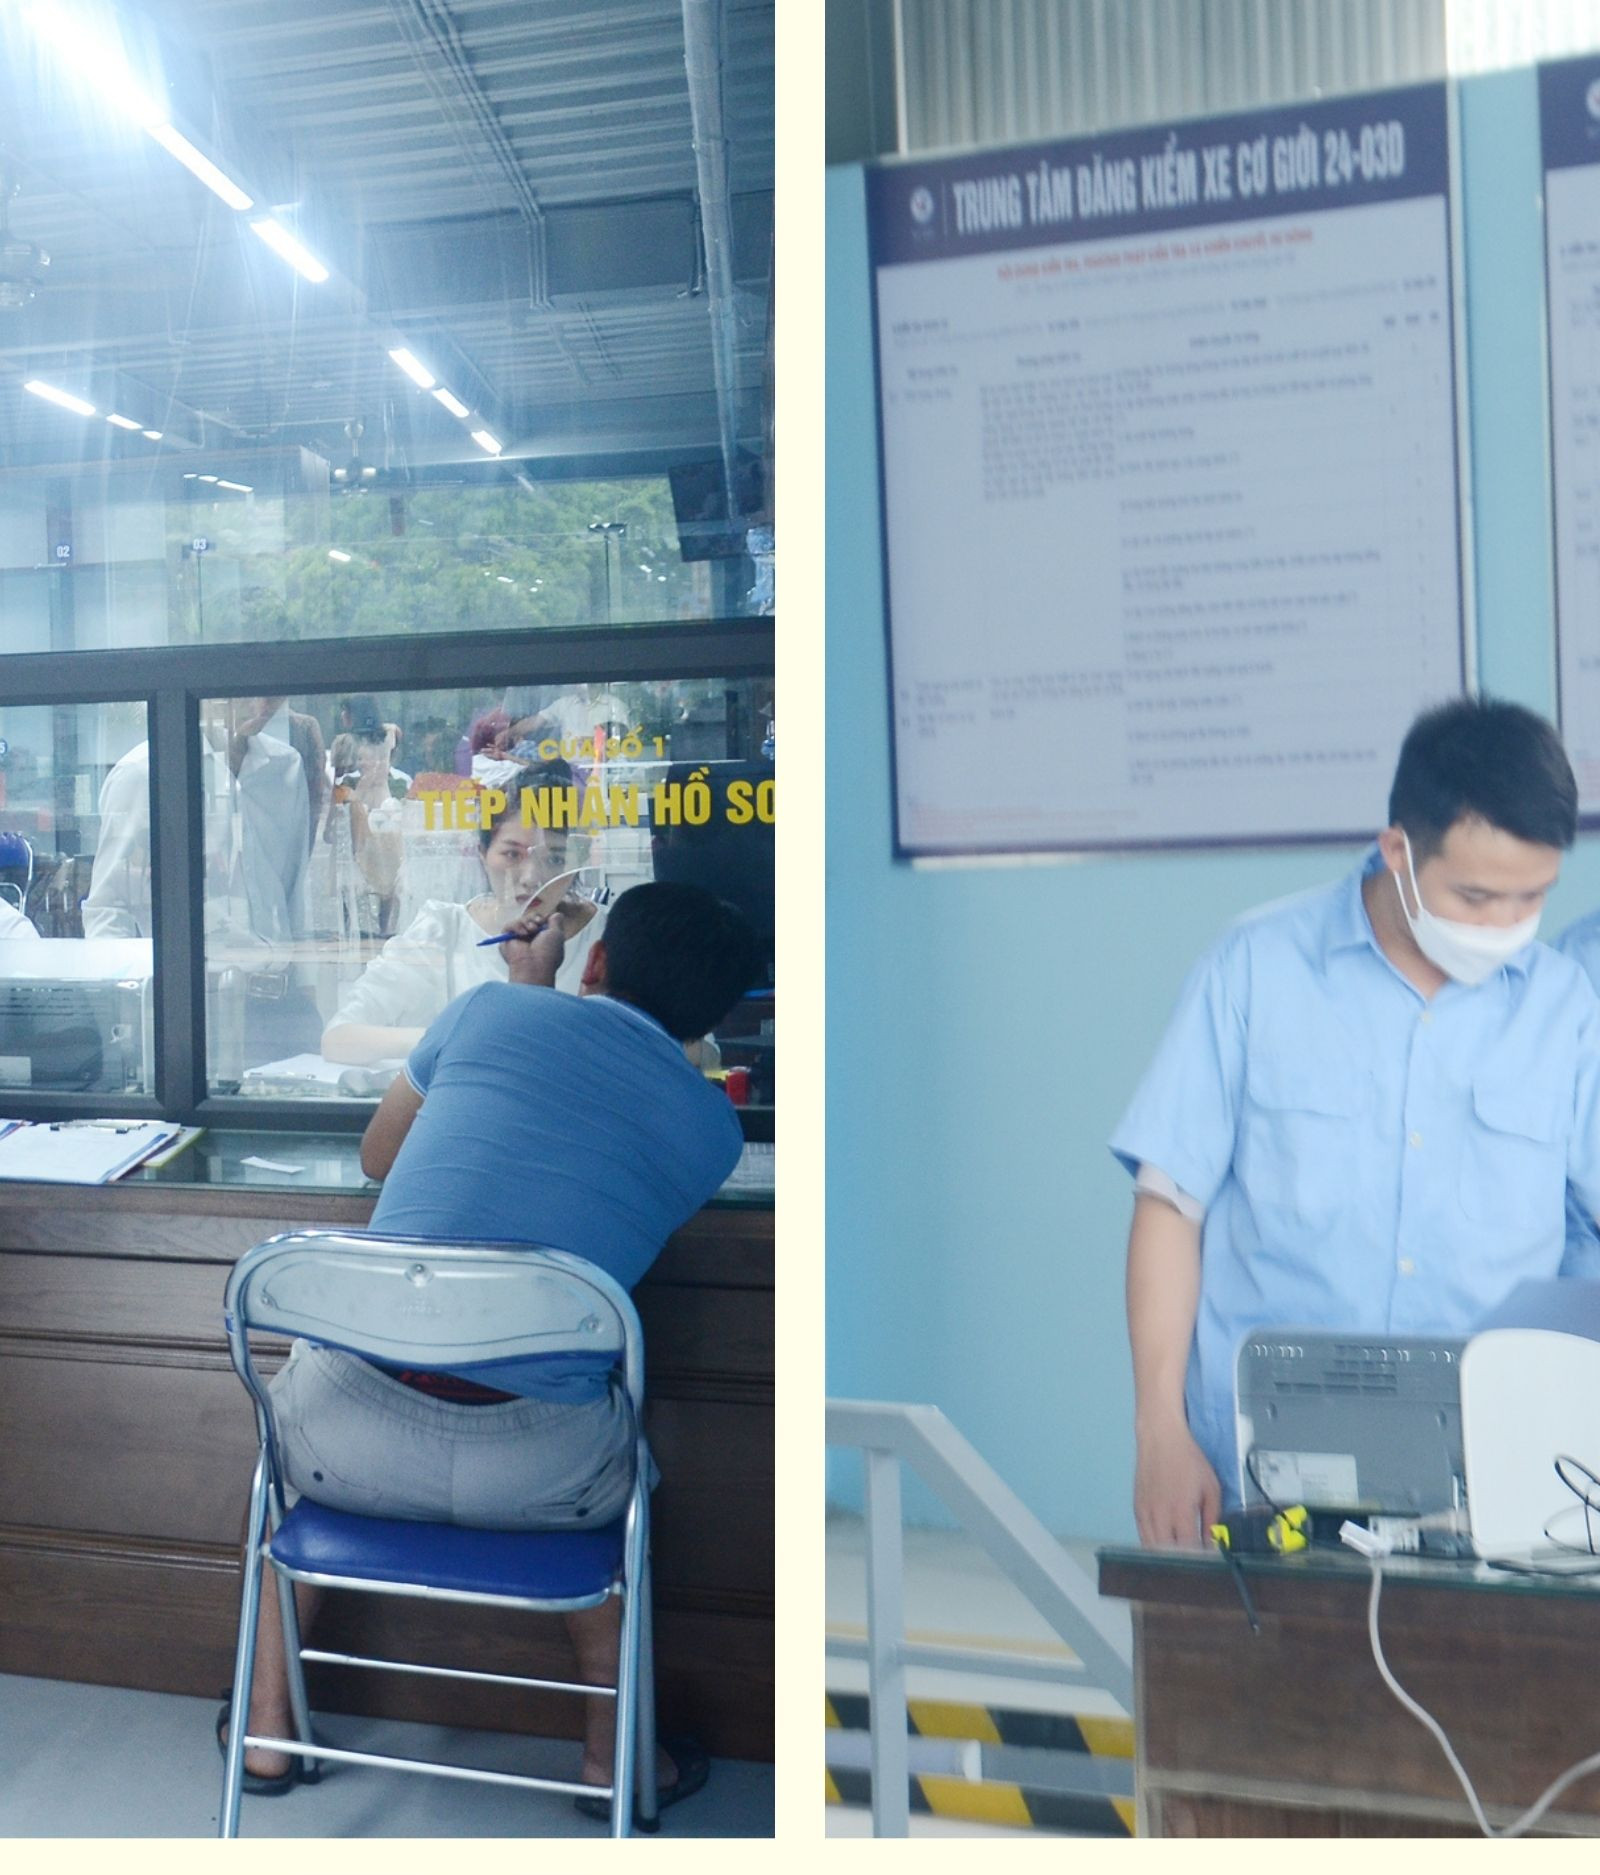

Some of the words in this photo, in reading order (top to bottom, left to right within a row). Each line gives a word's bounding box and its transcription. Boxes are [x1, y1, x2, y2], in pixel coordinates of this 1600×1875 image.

[953, 173, 1022, 235] TRUNG
[1027, 159, 1073, 225] TÂM
[1077, 150, 1137, 218] ĐĂNG
[1141, 131, 1198, 210] KIỂM
[1202, 145, 1231, 200] XE
[1236, 135, 1269, 197] CƠ
[1273, 122, 1319, 191] GIỚI
[1324, 119, 1405, 188] 24-03D
[56, 546, 70, 558] 02
[193, 538, 207, 550] 03
[538, 733, 593, 761] CỬA
[606, 726, 643, 759] SỐ
[652, 736, 665, 758] 1
[417, 777, 507, 831] TIẾP
[520, 776, 640, 837] NHẬN
[654, 767, 711, 826] HỒ
